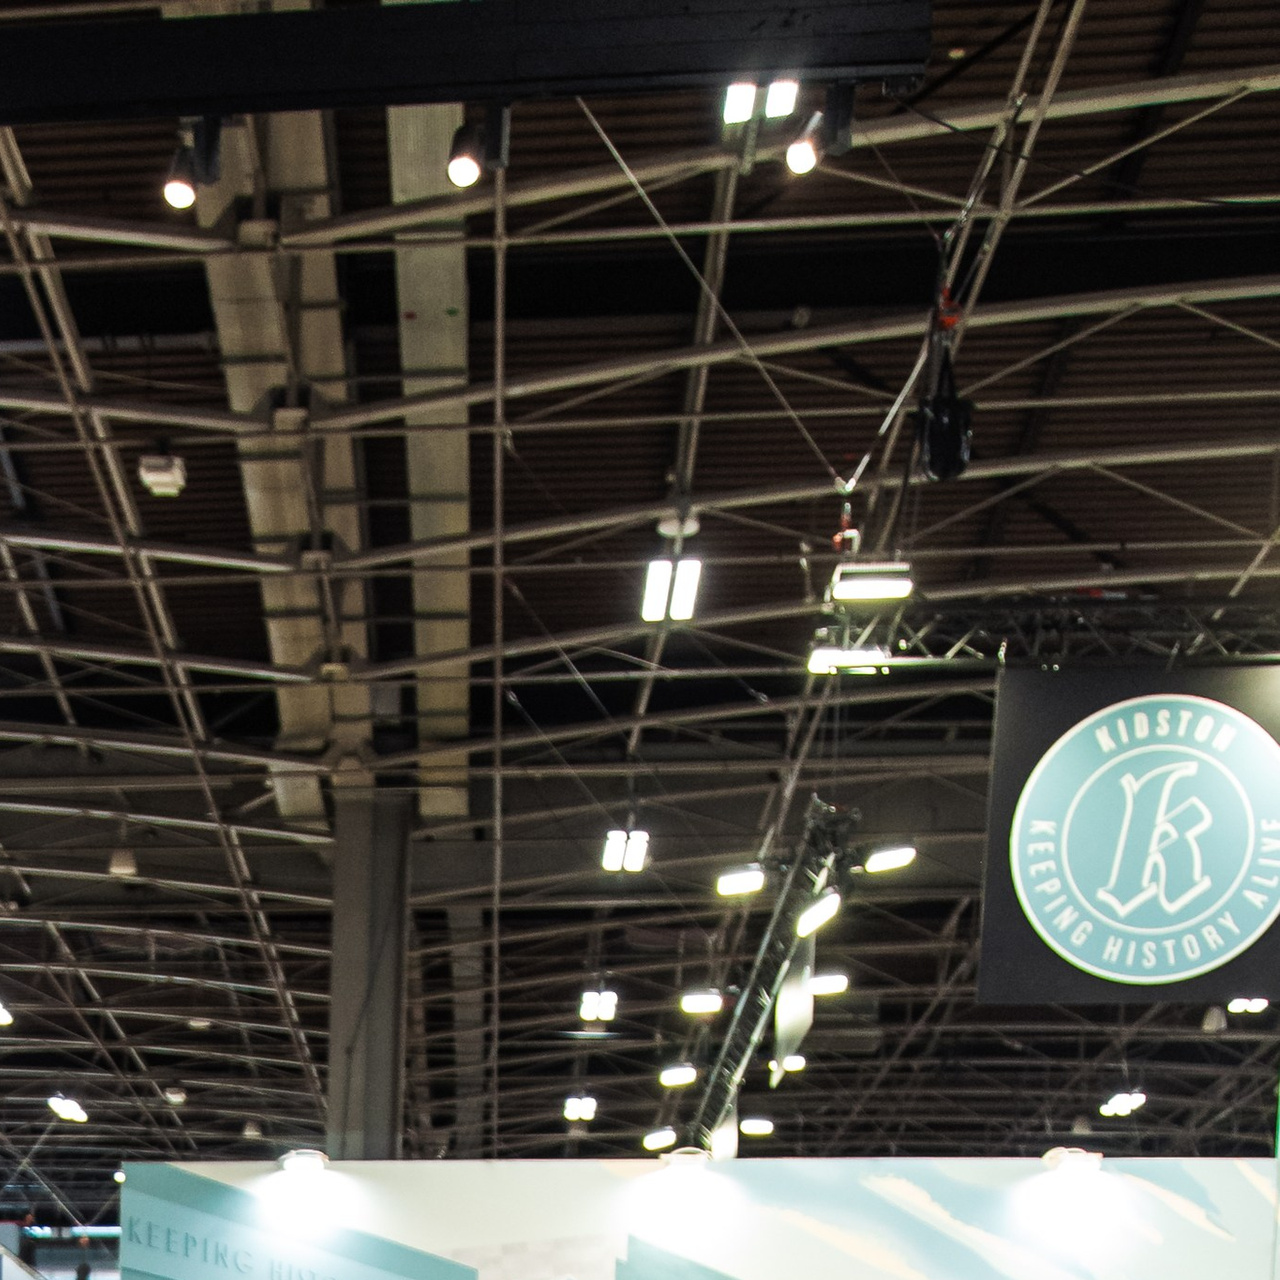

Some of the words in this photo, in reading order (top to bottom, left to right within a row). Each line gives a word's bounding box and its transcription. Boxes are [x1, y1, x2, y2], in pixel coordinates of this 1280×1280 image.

[1096, 710, 1235, 752] KIDSTON
[1029, 820, 1093, 945] KEEPING
[1103, 912, 1240, 967] HISTORY
[127, 1214, 255, 1275] KEEPING
